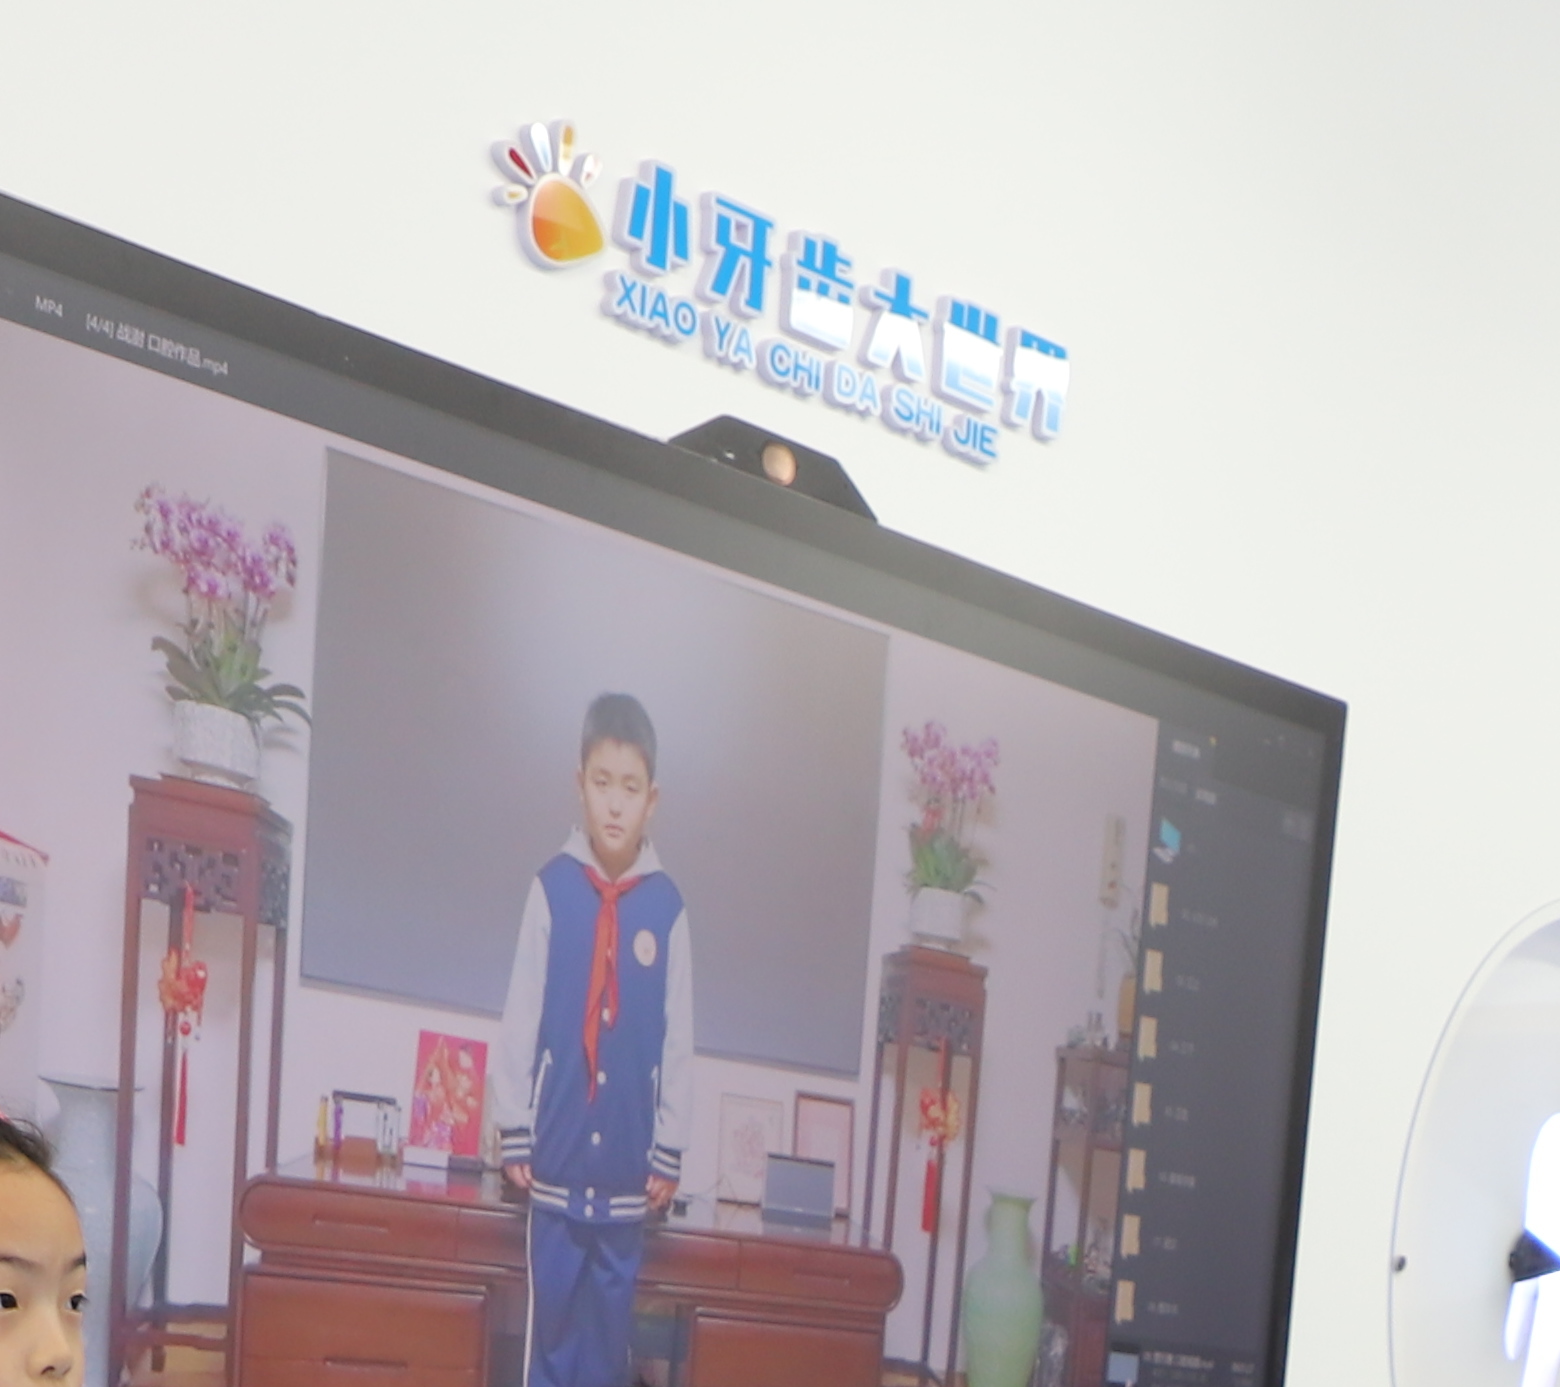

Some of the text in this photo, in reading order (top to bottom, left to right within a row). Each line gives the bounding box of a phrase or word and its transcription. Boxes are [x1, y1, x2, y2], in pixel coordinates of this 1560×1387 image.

[35, 295, 64, 318] MP4
[616, 274, 999, 459] XIAO YA CHI DA SHI JIE
[627, 163, 1071, 436] 小牙齿大世界
